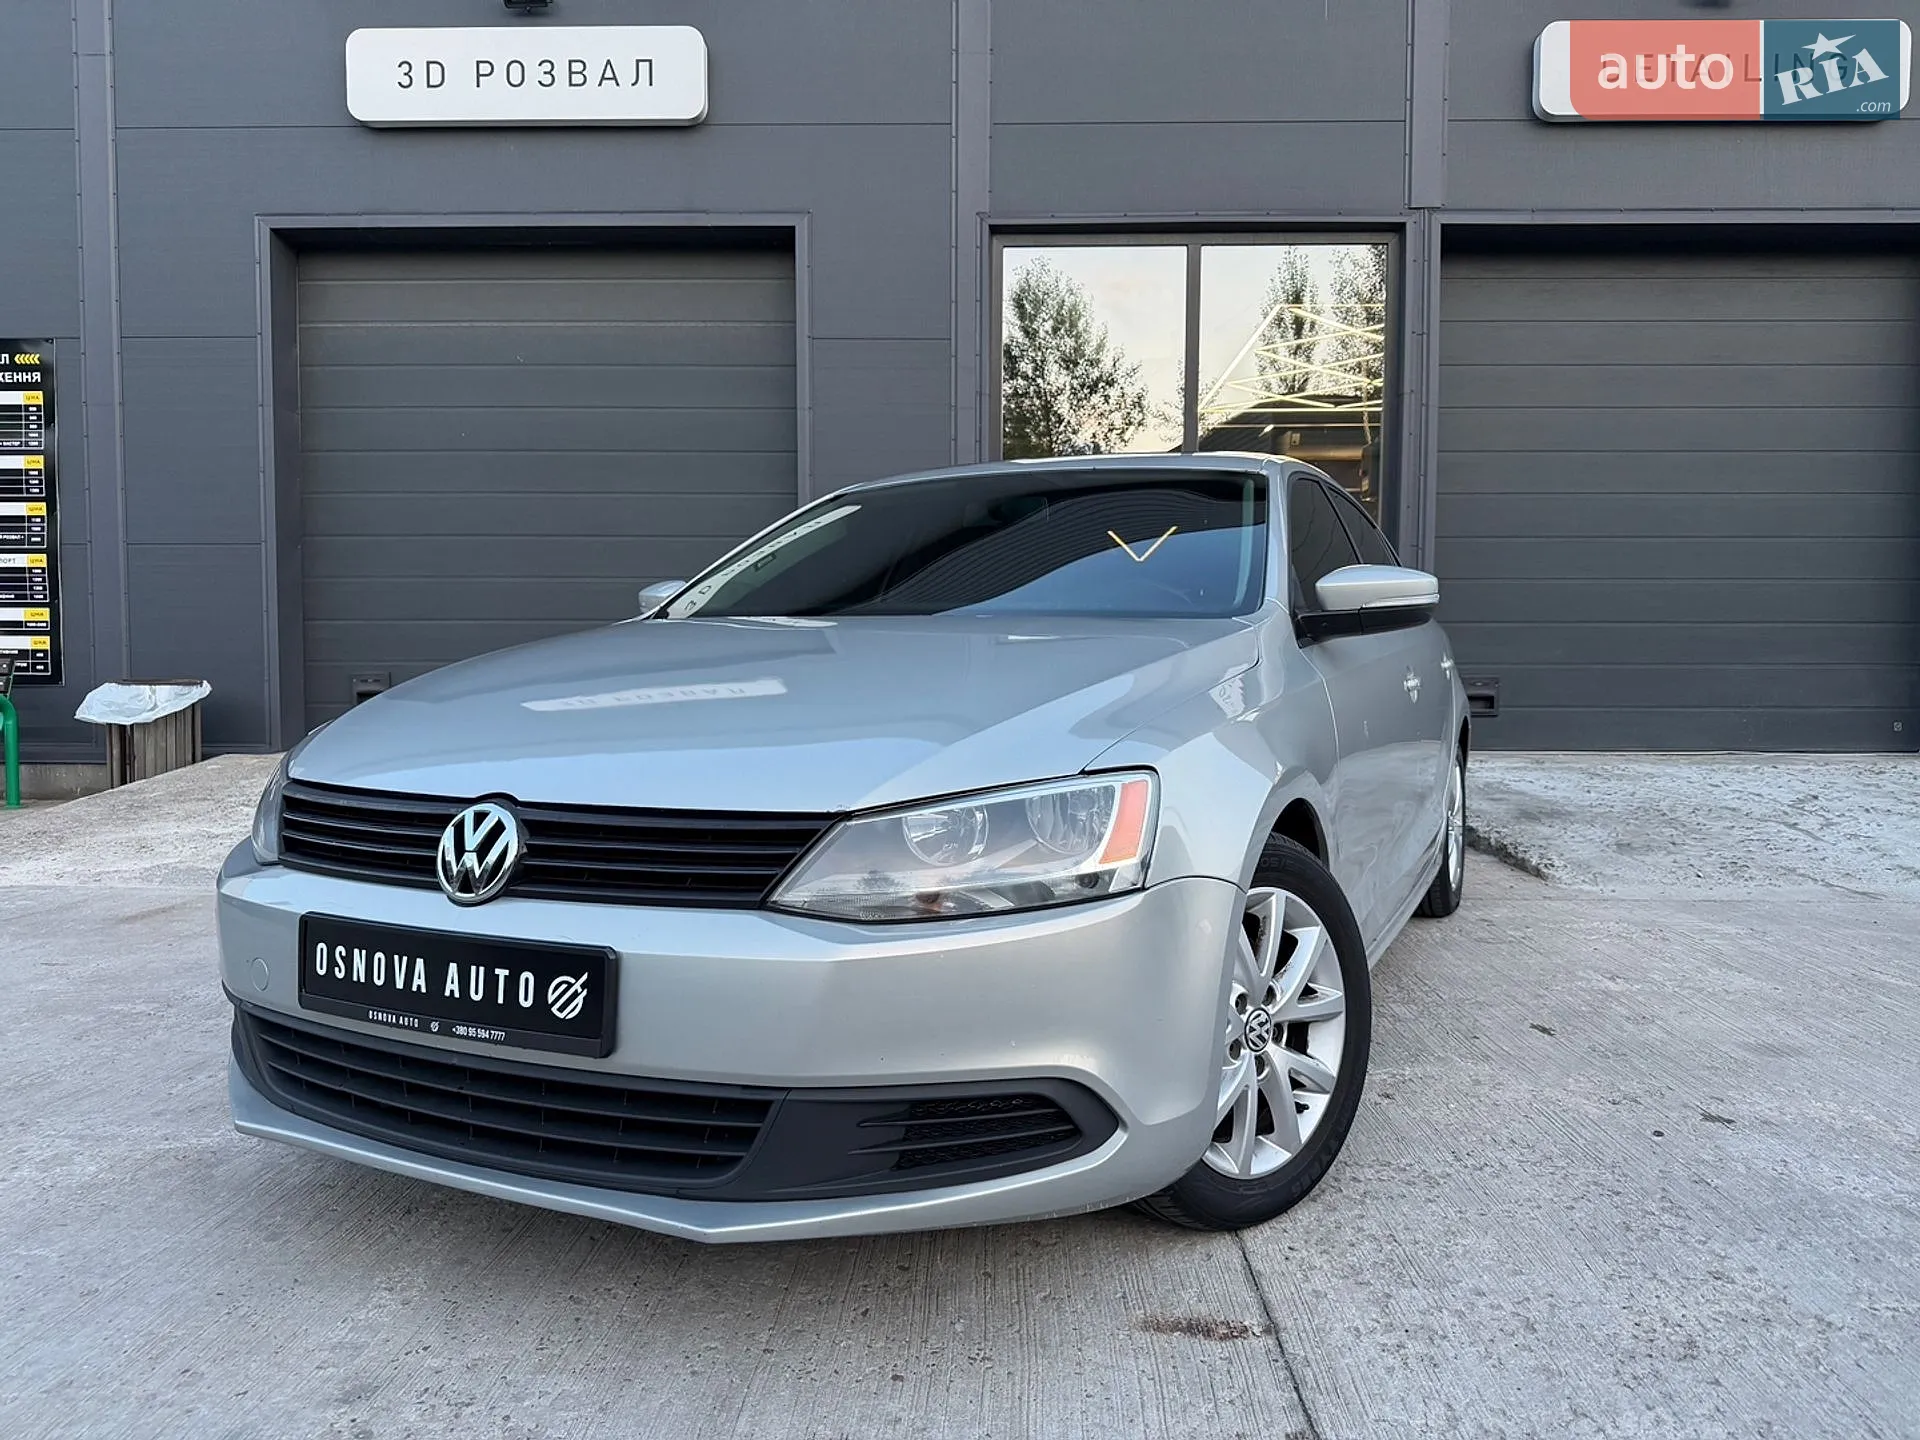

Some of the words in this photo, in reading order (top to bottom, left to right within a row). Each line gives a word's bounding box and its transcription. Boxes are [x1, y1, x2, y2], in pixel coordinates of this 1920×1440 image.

[397, 60, 446, 89] 3D
[475, 59, 653, 88] РОЗВАЛ
[315, 942, 427, 994] OSNOVA
[444, 962, 535, 1008] AUTO
[368, 1010, 397, 1024] OSNOVA
[399, 1015, 419, 1028] AUTO
